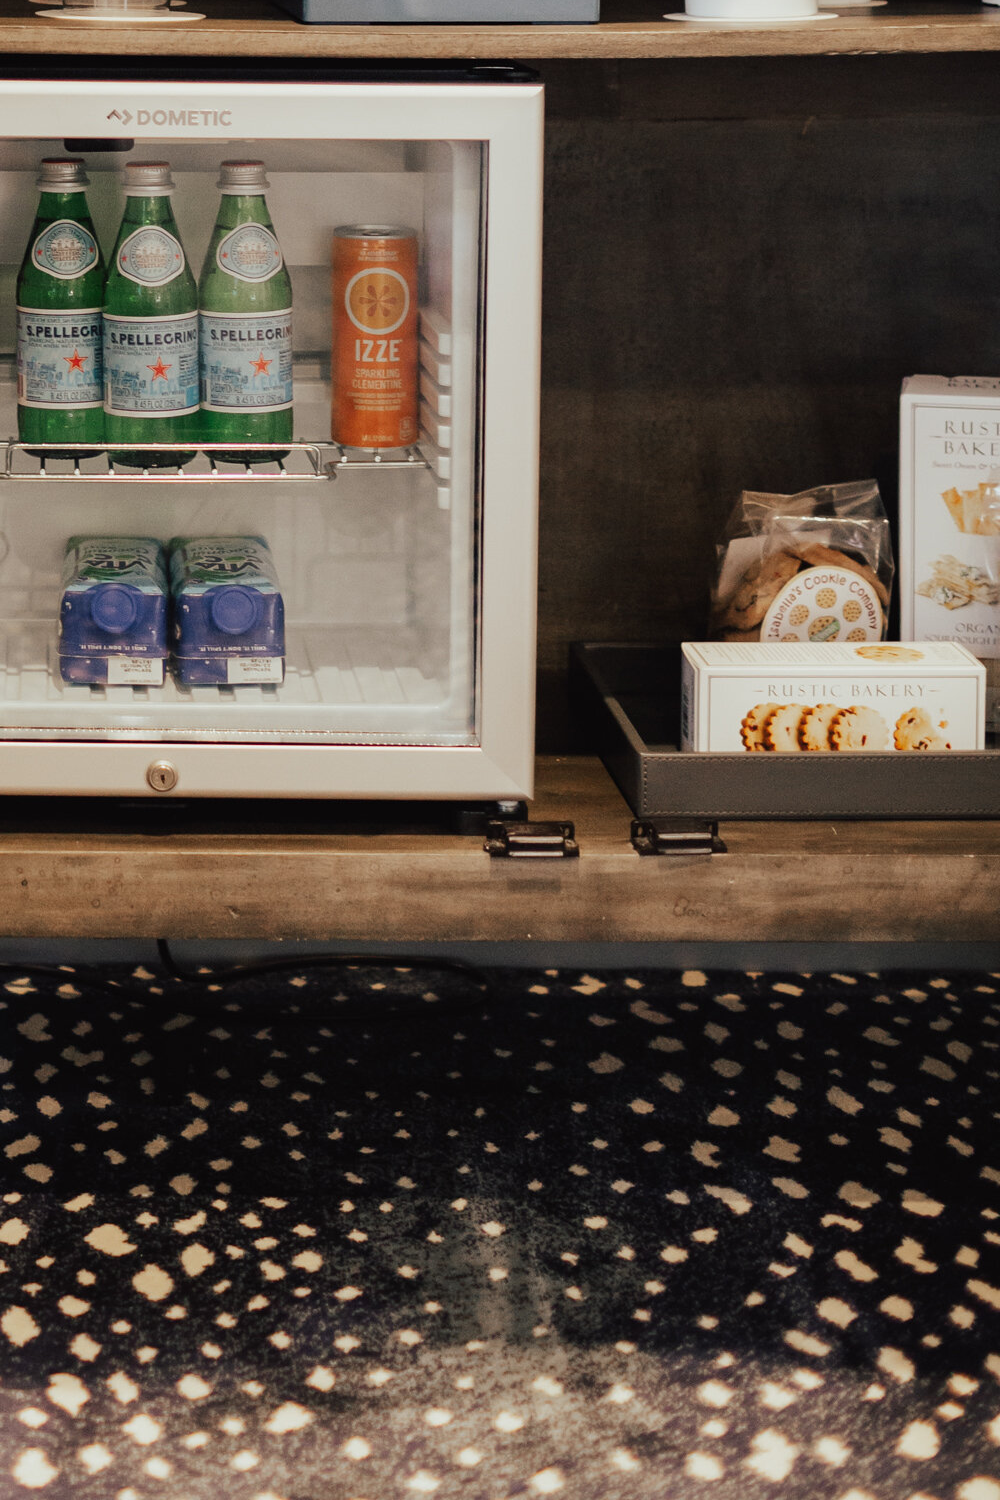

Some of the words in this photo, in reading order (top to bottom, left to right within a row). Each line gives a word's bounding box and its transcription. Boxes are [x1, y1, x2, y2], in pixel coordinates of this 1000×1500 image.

[137, 109, 233, 127] DOMETIC
[354, 339, 400, 362] IZZE
[354, 368, 400, 379] SPARKLING
[352, 379, 403, 390] CLEMENTINE
[767, 586, 802, 638] Isabella's
[803, 573, 847, 590] Cookie
[849, 581, 878, 630] Company
[767, 684, 841, 698] RUSTIC
[851, 684, 926, 698] BAKERY
